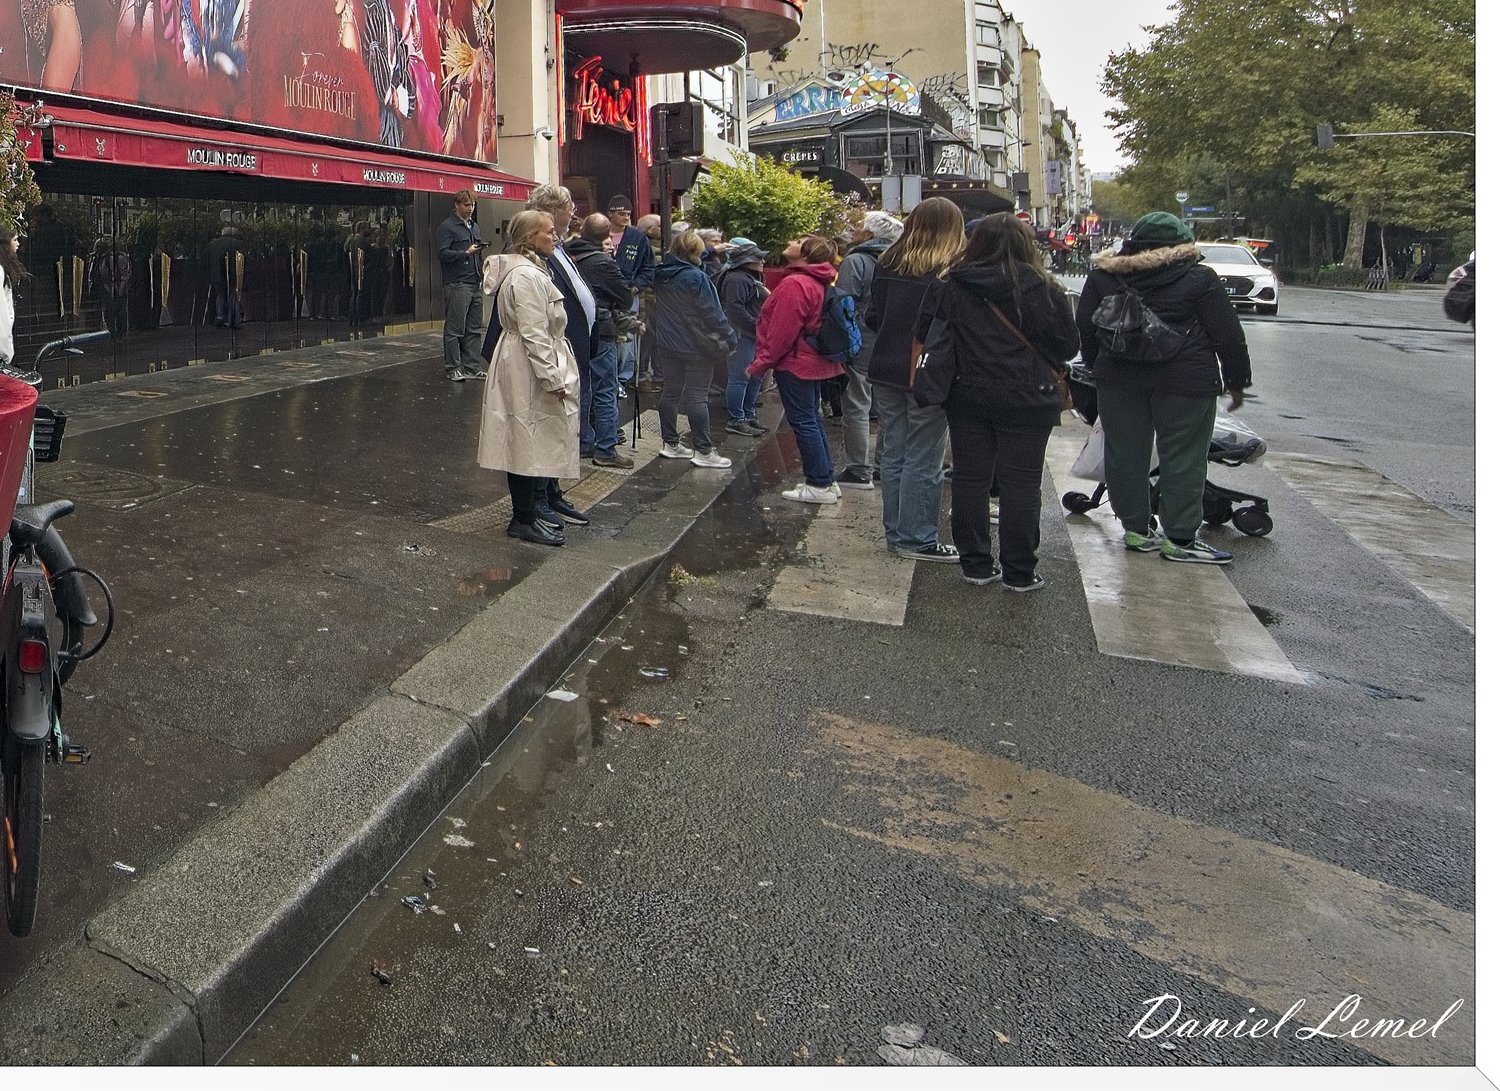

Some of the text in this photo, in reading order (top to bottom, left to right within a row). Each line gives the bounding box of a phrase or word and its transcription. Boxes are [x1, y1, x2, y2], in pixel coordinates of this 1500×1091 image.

[295, 52, 344, 87] Forever
[284, 75, 356, 120] MOULIN ROUGE
[187, 148, 257, 169] MOULIN ROUGE
